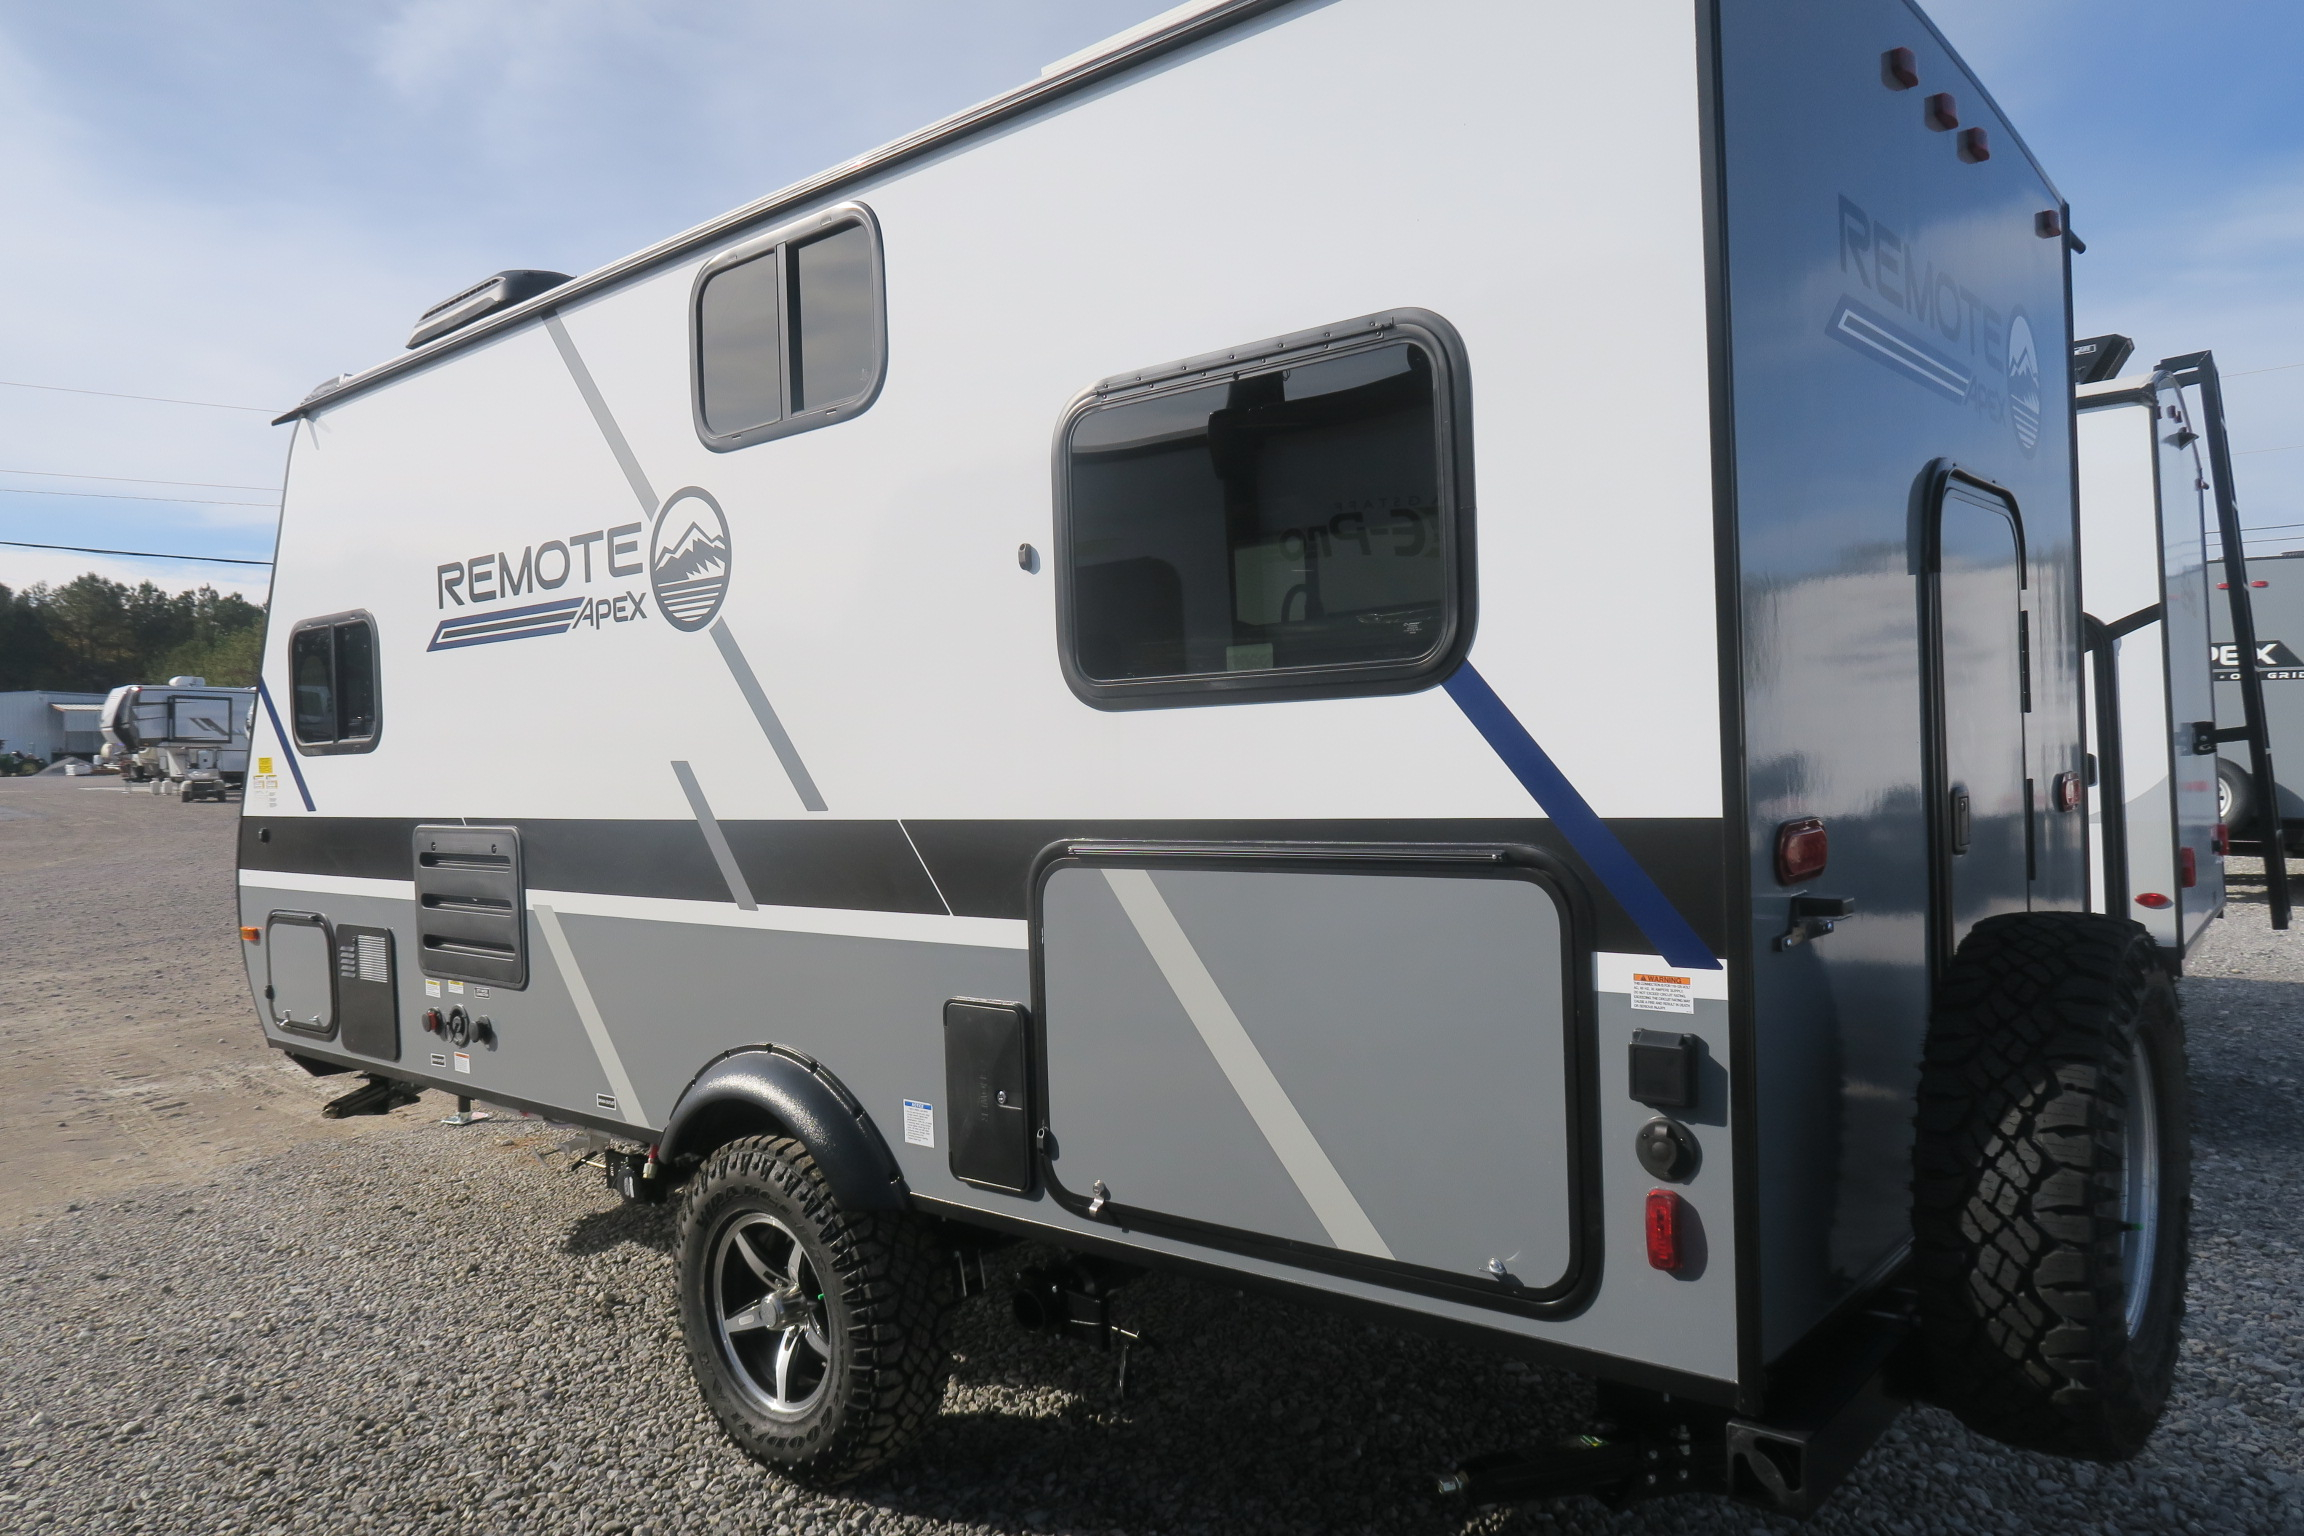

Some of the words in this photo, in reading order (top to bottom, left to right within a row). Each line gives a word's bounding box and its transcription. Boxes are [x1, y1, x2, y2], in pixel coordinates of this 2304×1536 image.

[1837, 193, 2004, 374] REMOTE
[437, 521, 643, 609] REMOTE
[1648, 975, 1682, 984] WARNING
[697, 1351, 833, 1450] GOODYEAR
